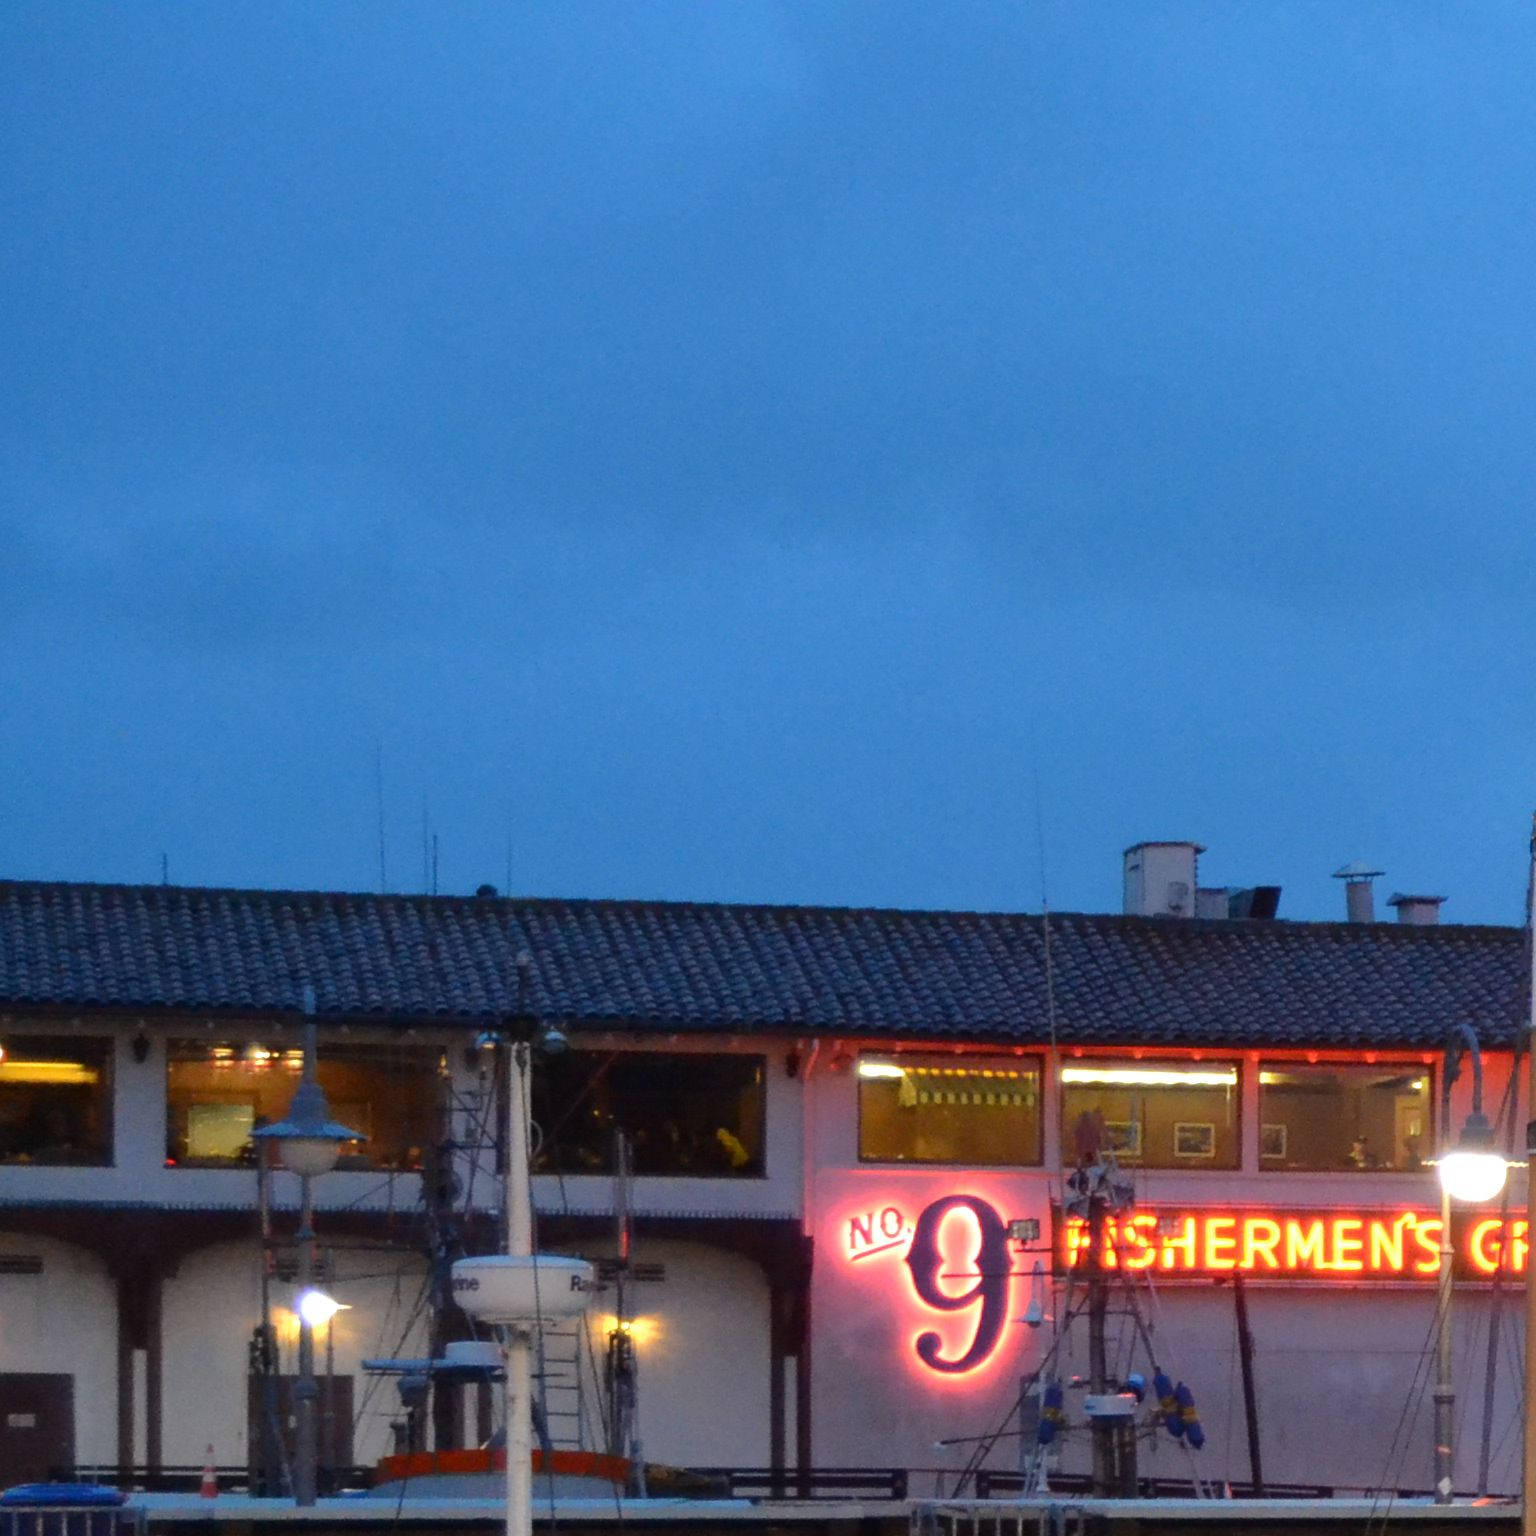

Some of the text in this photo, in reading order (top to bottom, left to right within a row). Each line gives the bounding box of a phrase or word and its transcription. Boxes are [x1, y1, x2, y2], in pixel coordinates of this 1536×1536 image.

[850, 1194, 1011, 1373] NO. 9
[1066, 1211, 1443, 1272] FISHERMEN'S
